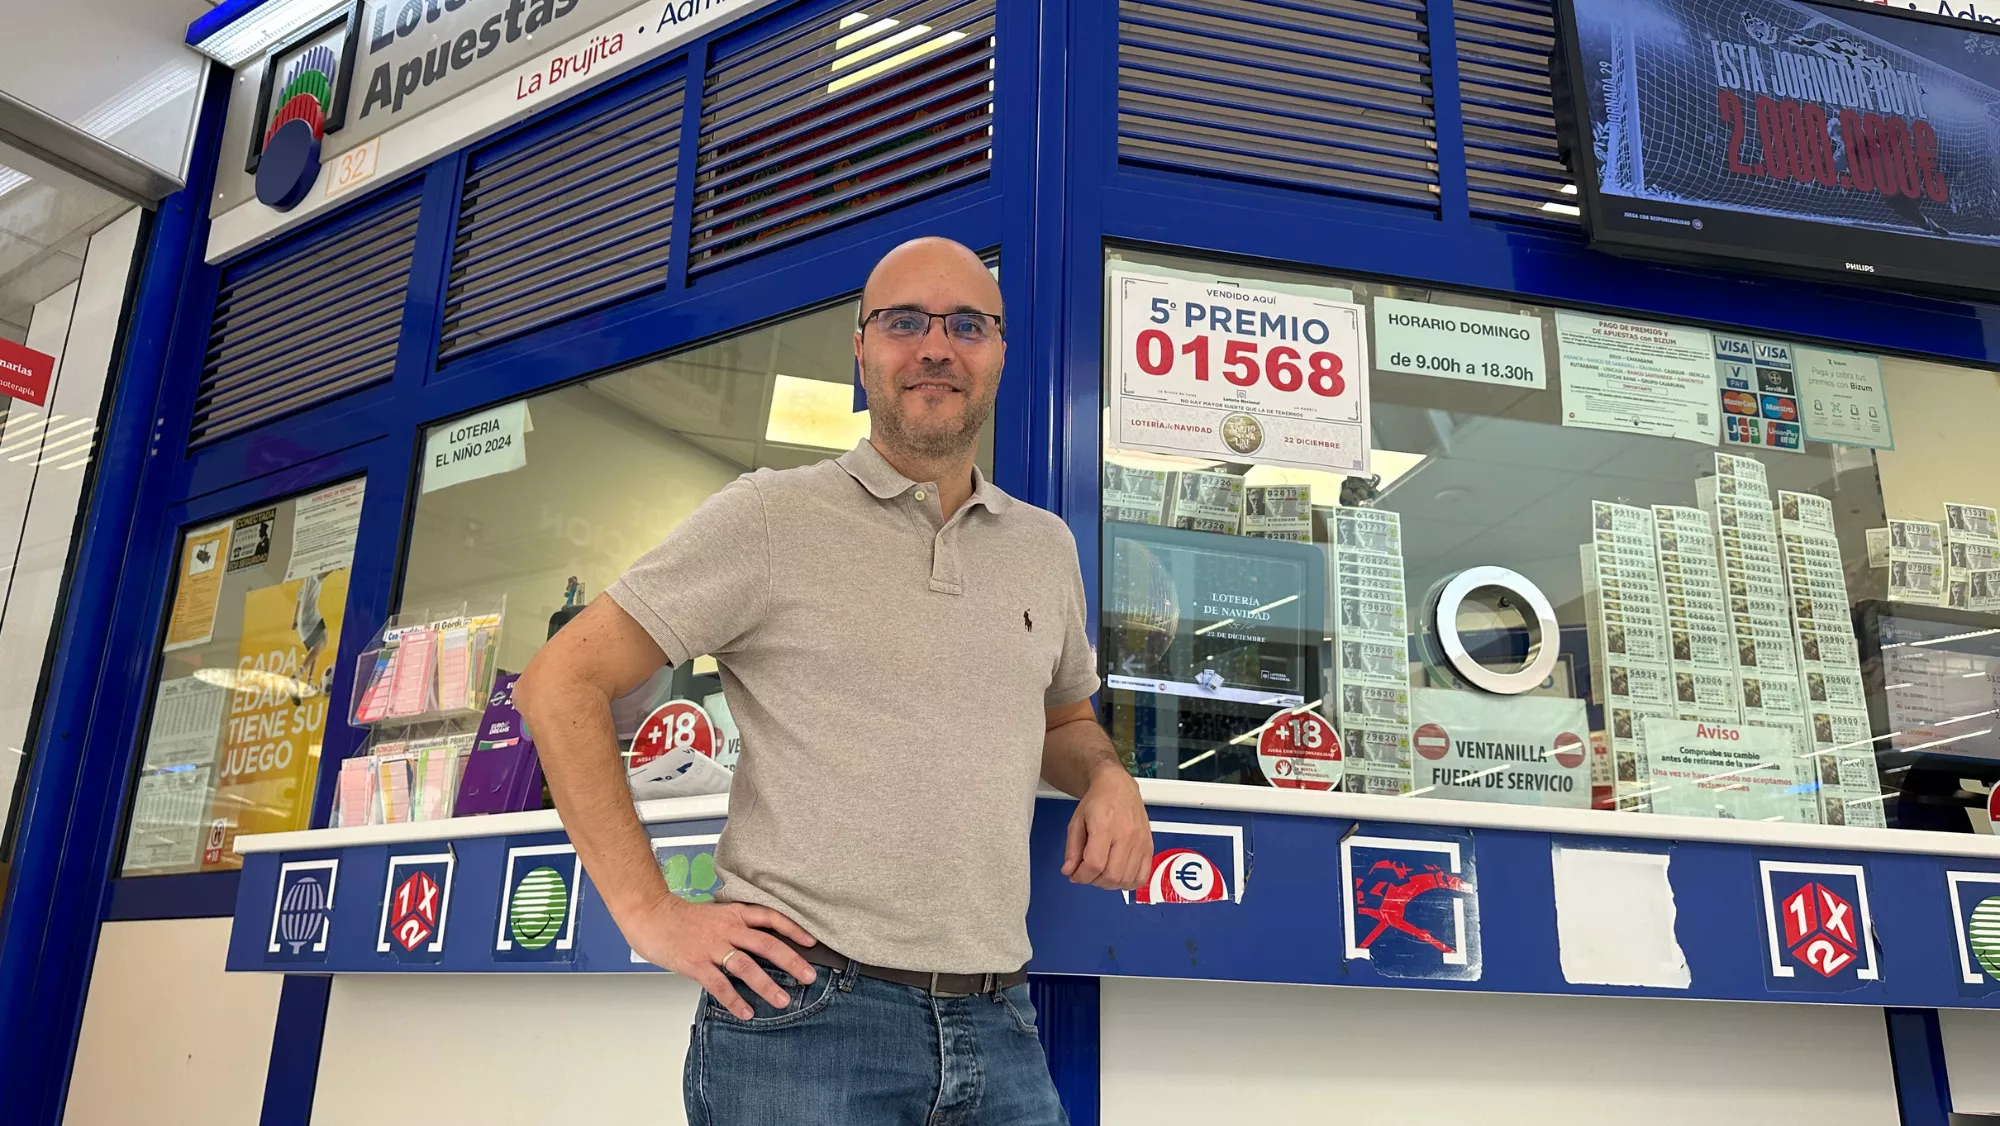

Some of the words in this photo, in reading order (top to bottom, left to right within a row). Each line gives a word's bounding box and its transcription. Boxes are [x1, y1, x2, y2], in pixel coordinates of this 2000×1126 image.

[516, 72, 542, 101] La
[548, 32, 624, 85] Brujita
[1599, 60, 1613, 78] 29
[1710, 40, 1768, 94] ESTA
[1770, 50, 1874, 111] JORNADA
[1717, 88, 1948, 204] 2.000.000€
[336, 147, 367, 184] 32
[1845, 262, 1875, 273] PHILIPS
[1206, 289, 1250, 302] VENDIDO
[1252, 295, 1277, 305] AQUÍ
[1184, 302, 1330, 345] PREMIO
[1388, 313, 1457, 332] HORARIO
[1460, 322, 1531, 341] DOMINGO
[1599, 321, 1618, 329] PAGO
[1630, 325, 1663, 336] PREMIOS
[1603, 329, 1639, 341] APUESTAS
[1653, 337, 1677, 345] BIZUM
[1719, 339, 1749, 354] VISA
[1756, 344, 1788, 360] VISA
[1135, 328, 1346, 398] 01568
[1390, 352, 1412, 367] de
[1416, 354, 1461, 373] 9.00h
[1466, 363, 1476, 375] a
[1481, 362, 1534, 382] 18.30h
[1730, 365, 1740, 377] V
[1812, 366, 1829, 377] Paga
[1835, 370, 1855, 380] cobra
[1850, 382, 1874, 392] Bizum
[1765, 403, 1794, 413] Maestro
[449, 418, 500, 445] LOTERIA
[1174, 424, 1213, 435] NAVIDAD
[1728, 424, 1759, 437] JCB
[1768, 428, 1799, 439] UnionPay
[1284, 436, 1294, 444] 22
[1296, 438, 1341, 449] DICIEMBRE
[435, 453, 449, 468] EL
[452, 442, 482, 463] NIÑO
[485, 434, 512, 454] 2024
[1267, 488, 1298, 497] 82819
[1267, 532, 1298, 540] 82819
[1906, 525, 1930, 533] 07909
[1212, 592, 1261, 606] LOTERÍA
[1204, 605, 1219, 615] DE
[1221, 607, 1271, 621] NAVIDAD
[1362, 603, 1392, 612] 79820
[1227, 633, 1266, 643] DICIEMBRE
[1363, 644, 1393, 655] 79820
[237, 646, 297, 682] CADA
[231, 684, 290, 714] EDAD
[1364, 688, 1395, 699] 79820
[228, 709, 289, 745] TIENE
[291, 703, 324, 734] SU
[648, 711, 697, 750] +18
[1275, 719, 1323, 749] +18
[1366, 732, 1397, 743] 79820
[1696, 723, 1740, 742] Aviso
[220, 740, 293, 778] JUEGO
[1456, 740, 1548, 763] VENTANILLA
[1679, 746, 1722, 759] Compruebe
[1733, 751, 1760, 760] cambio
[1661, 755, 1682, 763] antes
[1682, 755, 1692, 763] de
[1693, 757, 1724, 767] retirarse
[1726, 759, 1735, 767] de
[1736, 760, 1743, 768] la
[1367, 777, 1399, 788] 79820
[1432, 767, 1481, 788] FUERA
[1486, 771, 1504, 790] DE
[1507, 773, 1574, 793] SERVICIO
[1652, 768, 1668, 776] Una
[1753, 775, 1793, 787] aceptamos
